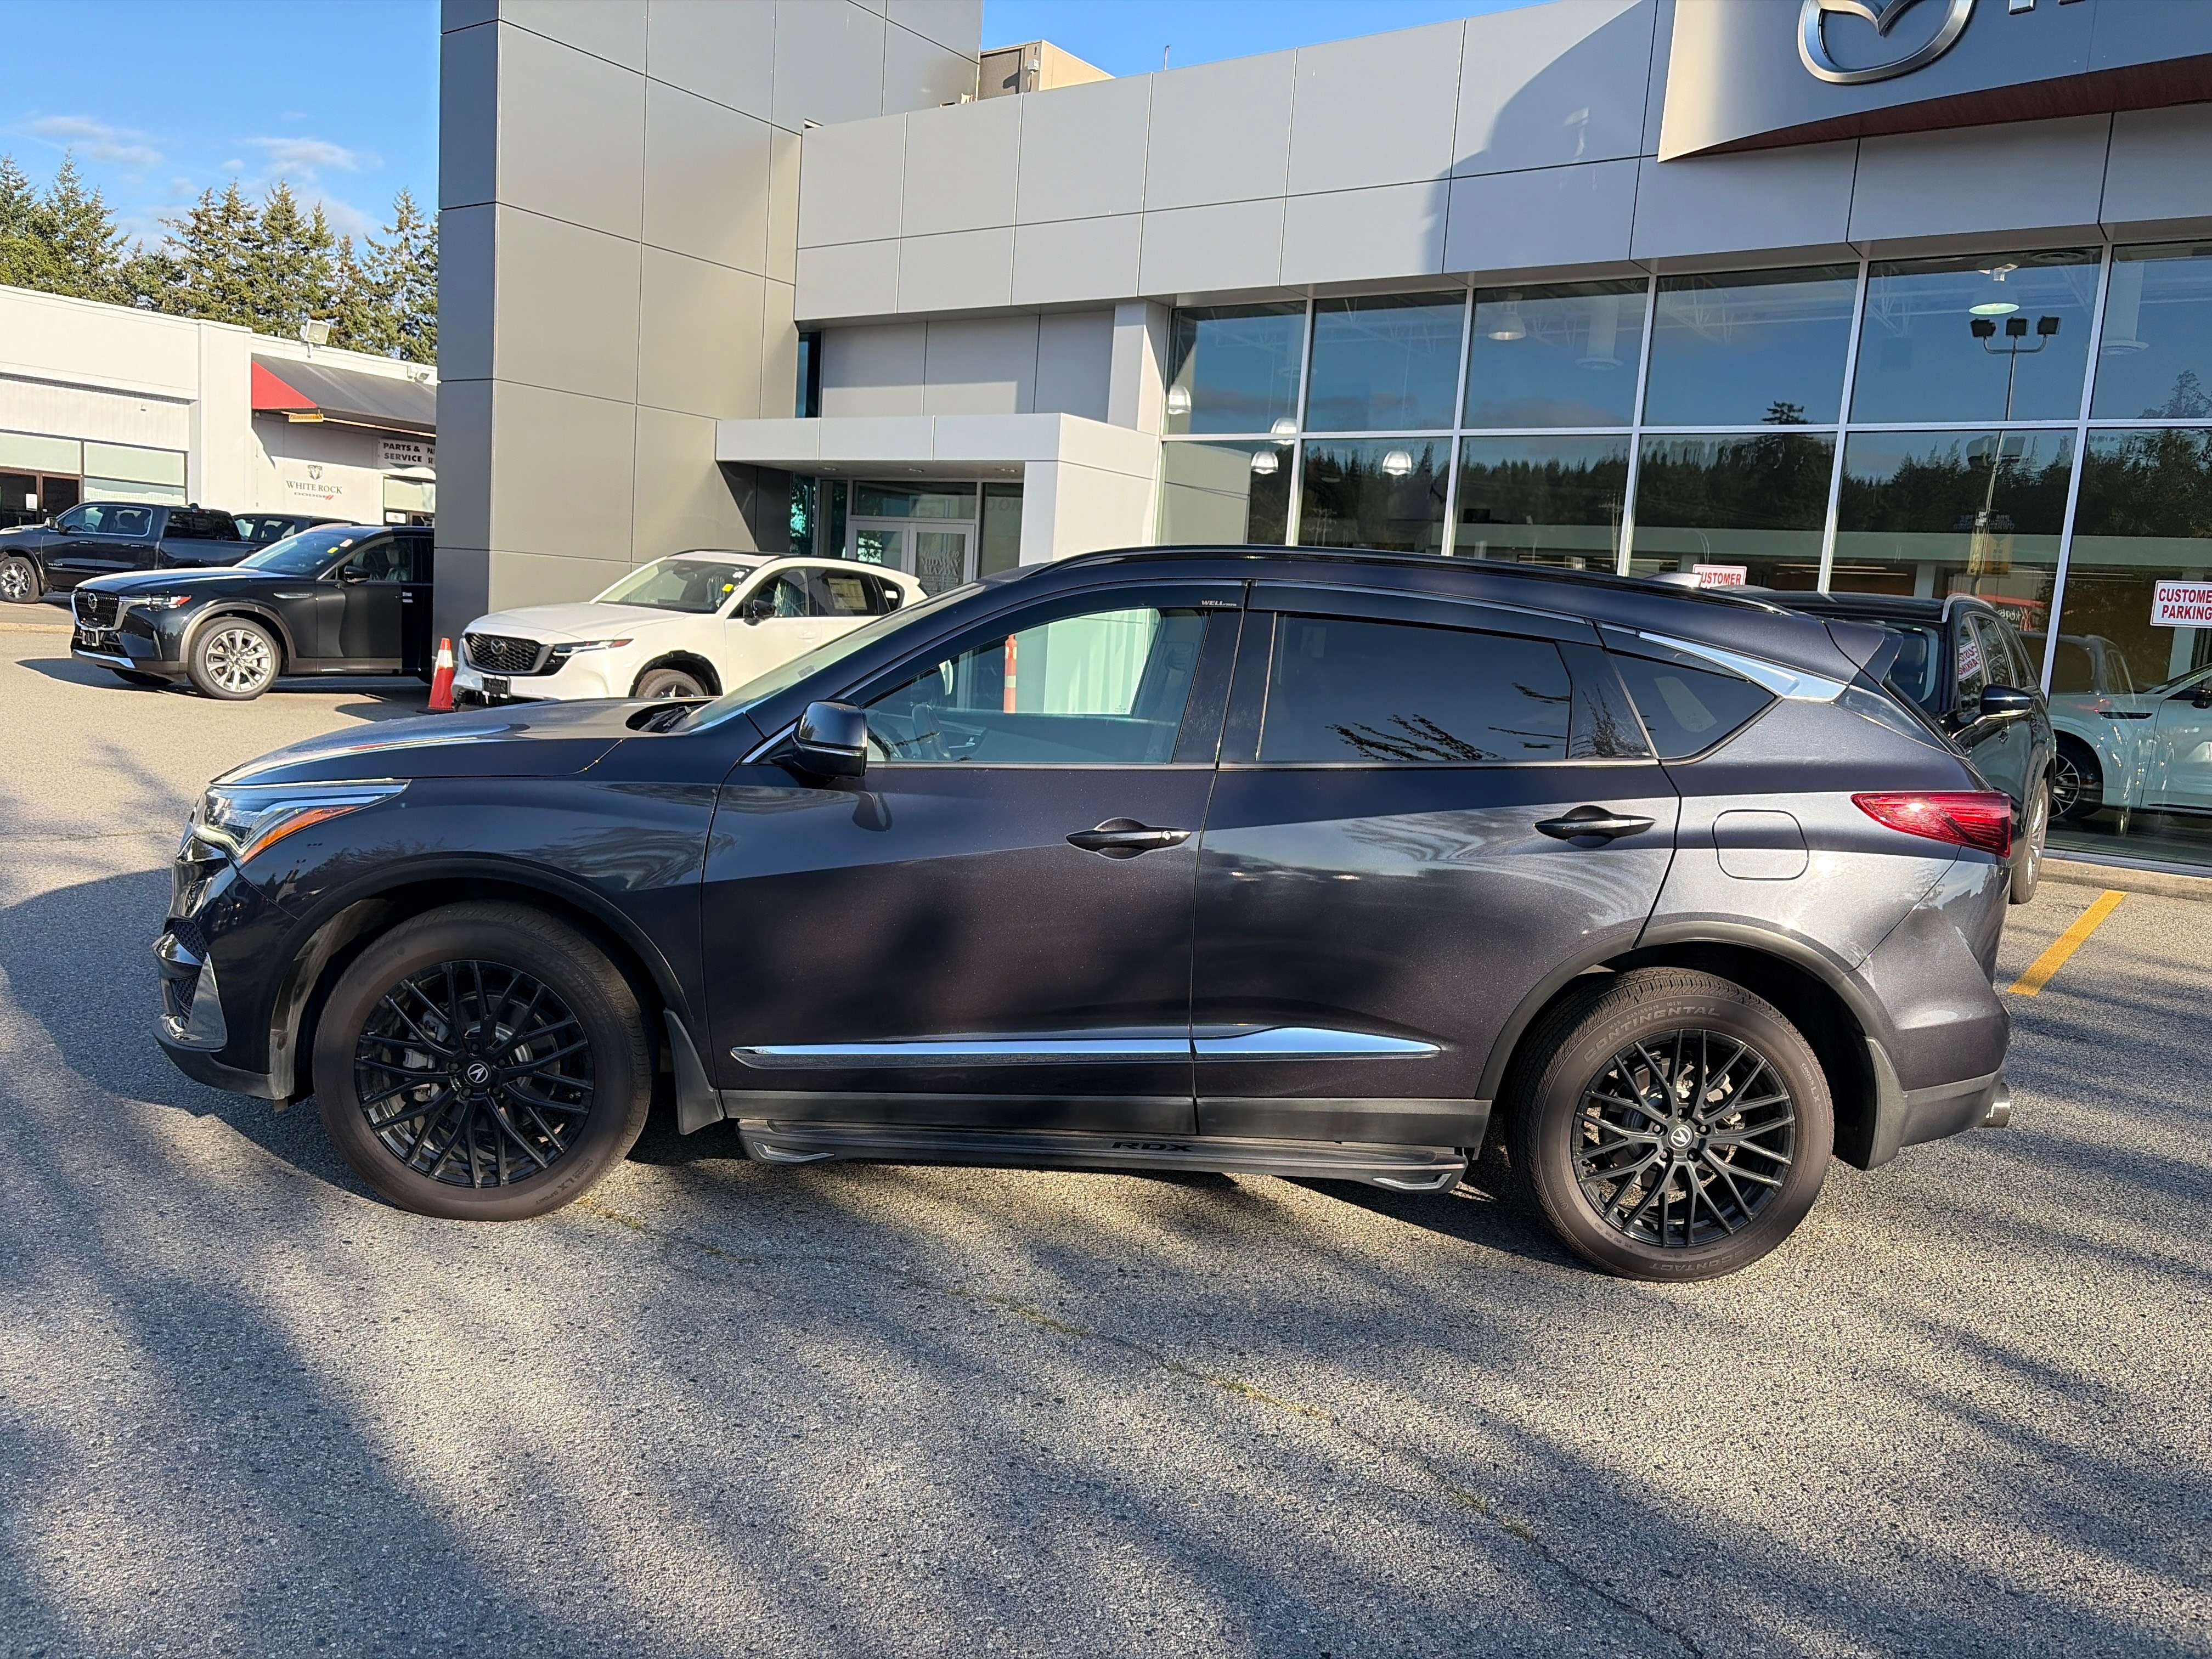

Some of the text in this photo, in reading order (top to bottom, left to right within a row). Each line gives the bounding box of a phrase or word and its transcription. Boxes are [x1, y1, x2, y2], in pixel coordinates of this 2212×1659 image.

[383, 443, 411, 451] PARTS
[384, 453, 422, 462] SERVICE
[285, 481, 342, 494] WHITE ROCK
[1701, 572, 1741, 585] USTOMER
[2159, 588, 2212, 603] CUSTOME
[2162, 605, 2212, 620] PARKING
[1584, 1006, 1720, 1062] CONTINENTAL
[1810, 1086, 1820, 1103] LX
[1111, 1142, 1194, 1152] RDX
